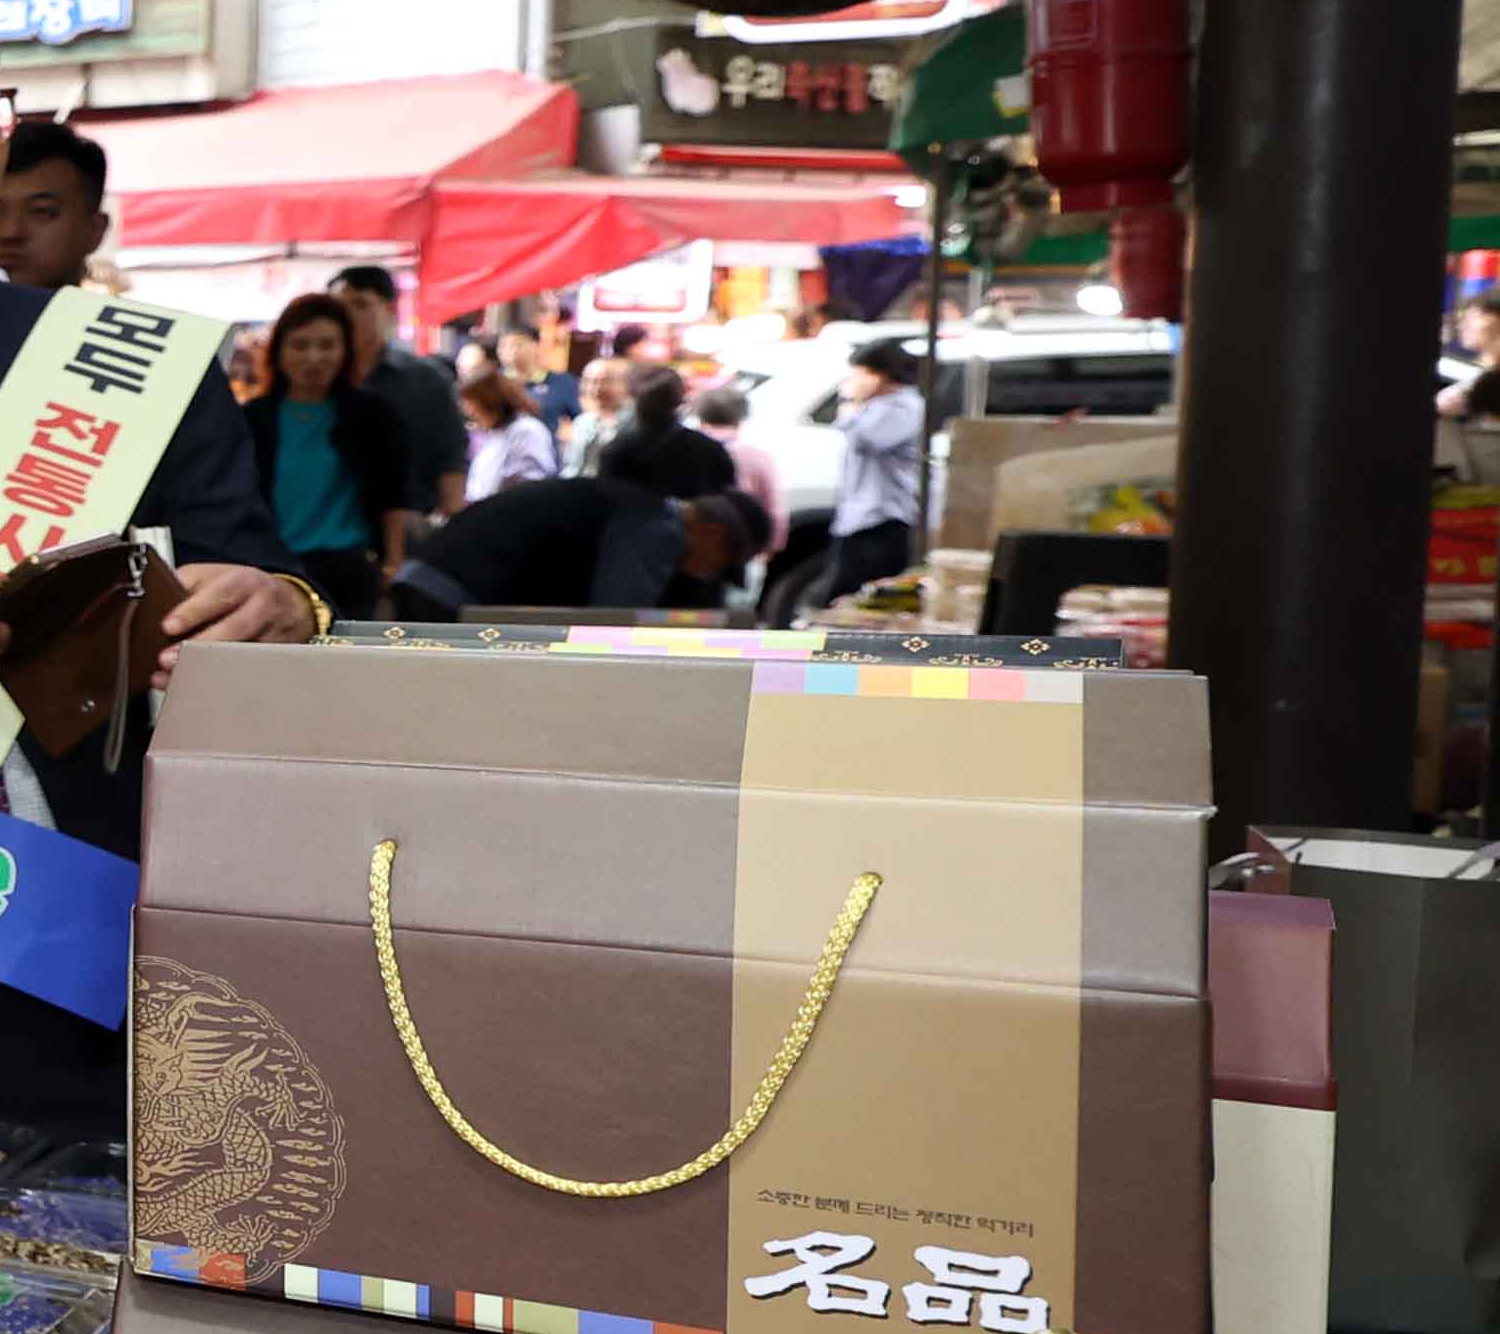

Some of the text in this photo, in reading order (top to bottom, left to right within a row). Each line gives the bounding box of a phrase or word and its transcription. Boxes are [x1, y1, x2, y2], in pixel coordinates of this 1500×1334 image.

[64, 305, 176, 394] 모두
[756, 1188, 810, 1209] 소중한
[856, 1202, 909, 1221] 드리는
[978, 1217, 1034, 1238] 먹거리
